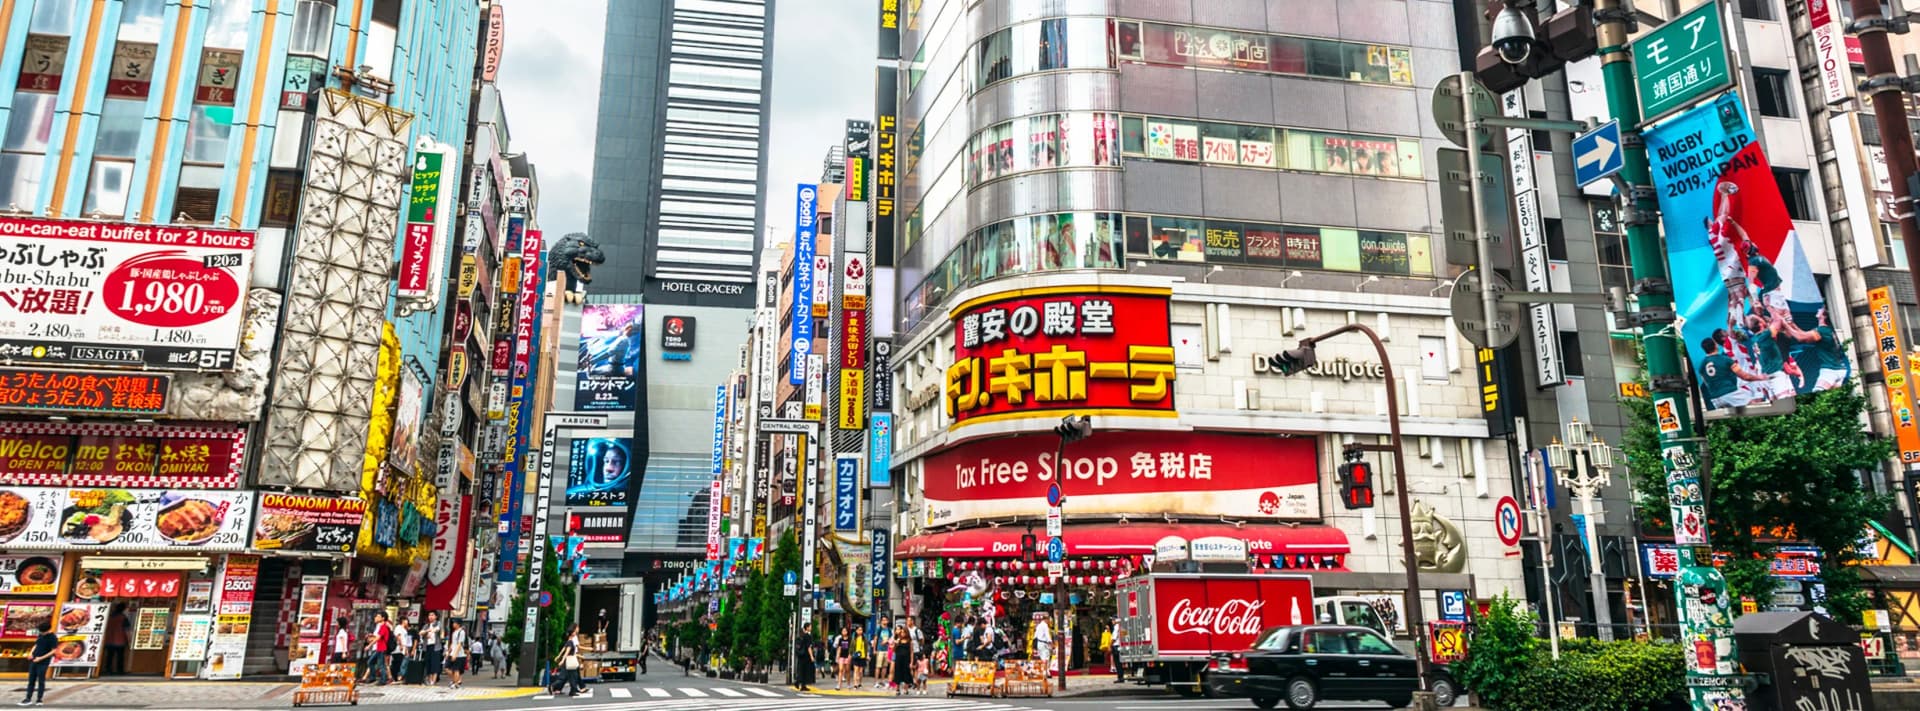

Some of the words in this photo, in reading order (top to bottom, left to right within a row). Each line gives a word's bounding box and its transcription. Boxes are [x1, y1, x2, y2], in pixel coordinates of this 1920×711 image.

[1646, 15, 1706, 66] モア
[1653, 56, 1712, 99] 靖国通り
[1174, 137, 1199, 160] 新宿
[1204, 140, 1237, 161] アイドル
[1241, 143, 1273, 165] ステージ
[1657, 130, 1704, 162] RUGBY
[1662, 148, 1713, 179] WORLD
[1714, 133, 1748, 158] CUP
[1667, 173, 1706, 198] 2019,
[1706, 151, 1759, 184] JAPAN
[101, 227, 151, 243] buffet
[156, 230, 180, 244] for
[184, 231, 198, 244] 2
[201, 232, 250, 248] hours
[1205, 229, 1241, 249] 販売
[1246, 236, 1281, 248] ブランド
[1286, 238, 1319, 251] 時計
[409, 231, 428, 288] ひょうたん
[117, 280, 205, 317] 1,980
[203, 303, 225, 315] yen
[661, 281, 695, 292] HOTEL
[696, 283, 744, 295] GRACERY
[963, 300, 1115, 348] 驚安の殿堂
[200, 350, 231, 368] 5F
[1536, 308, 1554, 382] ミステリアス
[1880, 336, 1902, 371] 麻雀
[579, 379, 635, 391] ロケットマン
[8, 457, 45, 470] OPEN
[74, 460, 105, 471] 12:00
[956, 463, 977, 490] Tax
[980, 458, 1029, 485] Free
[1037, 452, 1119, 487] Shop
[1129, 450, 1214, 481] 免税店
[264, 494, 332, 511] OKONOMI
[335, 499, 367, 512] YAKI
[568, 491, 626, 501] アド・アストラ
[838, 460, 855, 527] カラオケ
[583, 516, 624, 528] MARUHAN
[531, 533, 545, 575] ROAD
[873, 531, 886, 586] カラオケ
[992, 541, 1017, 553] Don
[663, 560, 685, 569] TOHO
[104, 577, 179, 594] とらそば
[873, 588, 885, 597] B1
[1168, 598, 1266, 635] Coca-Cola
